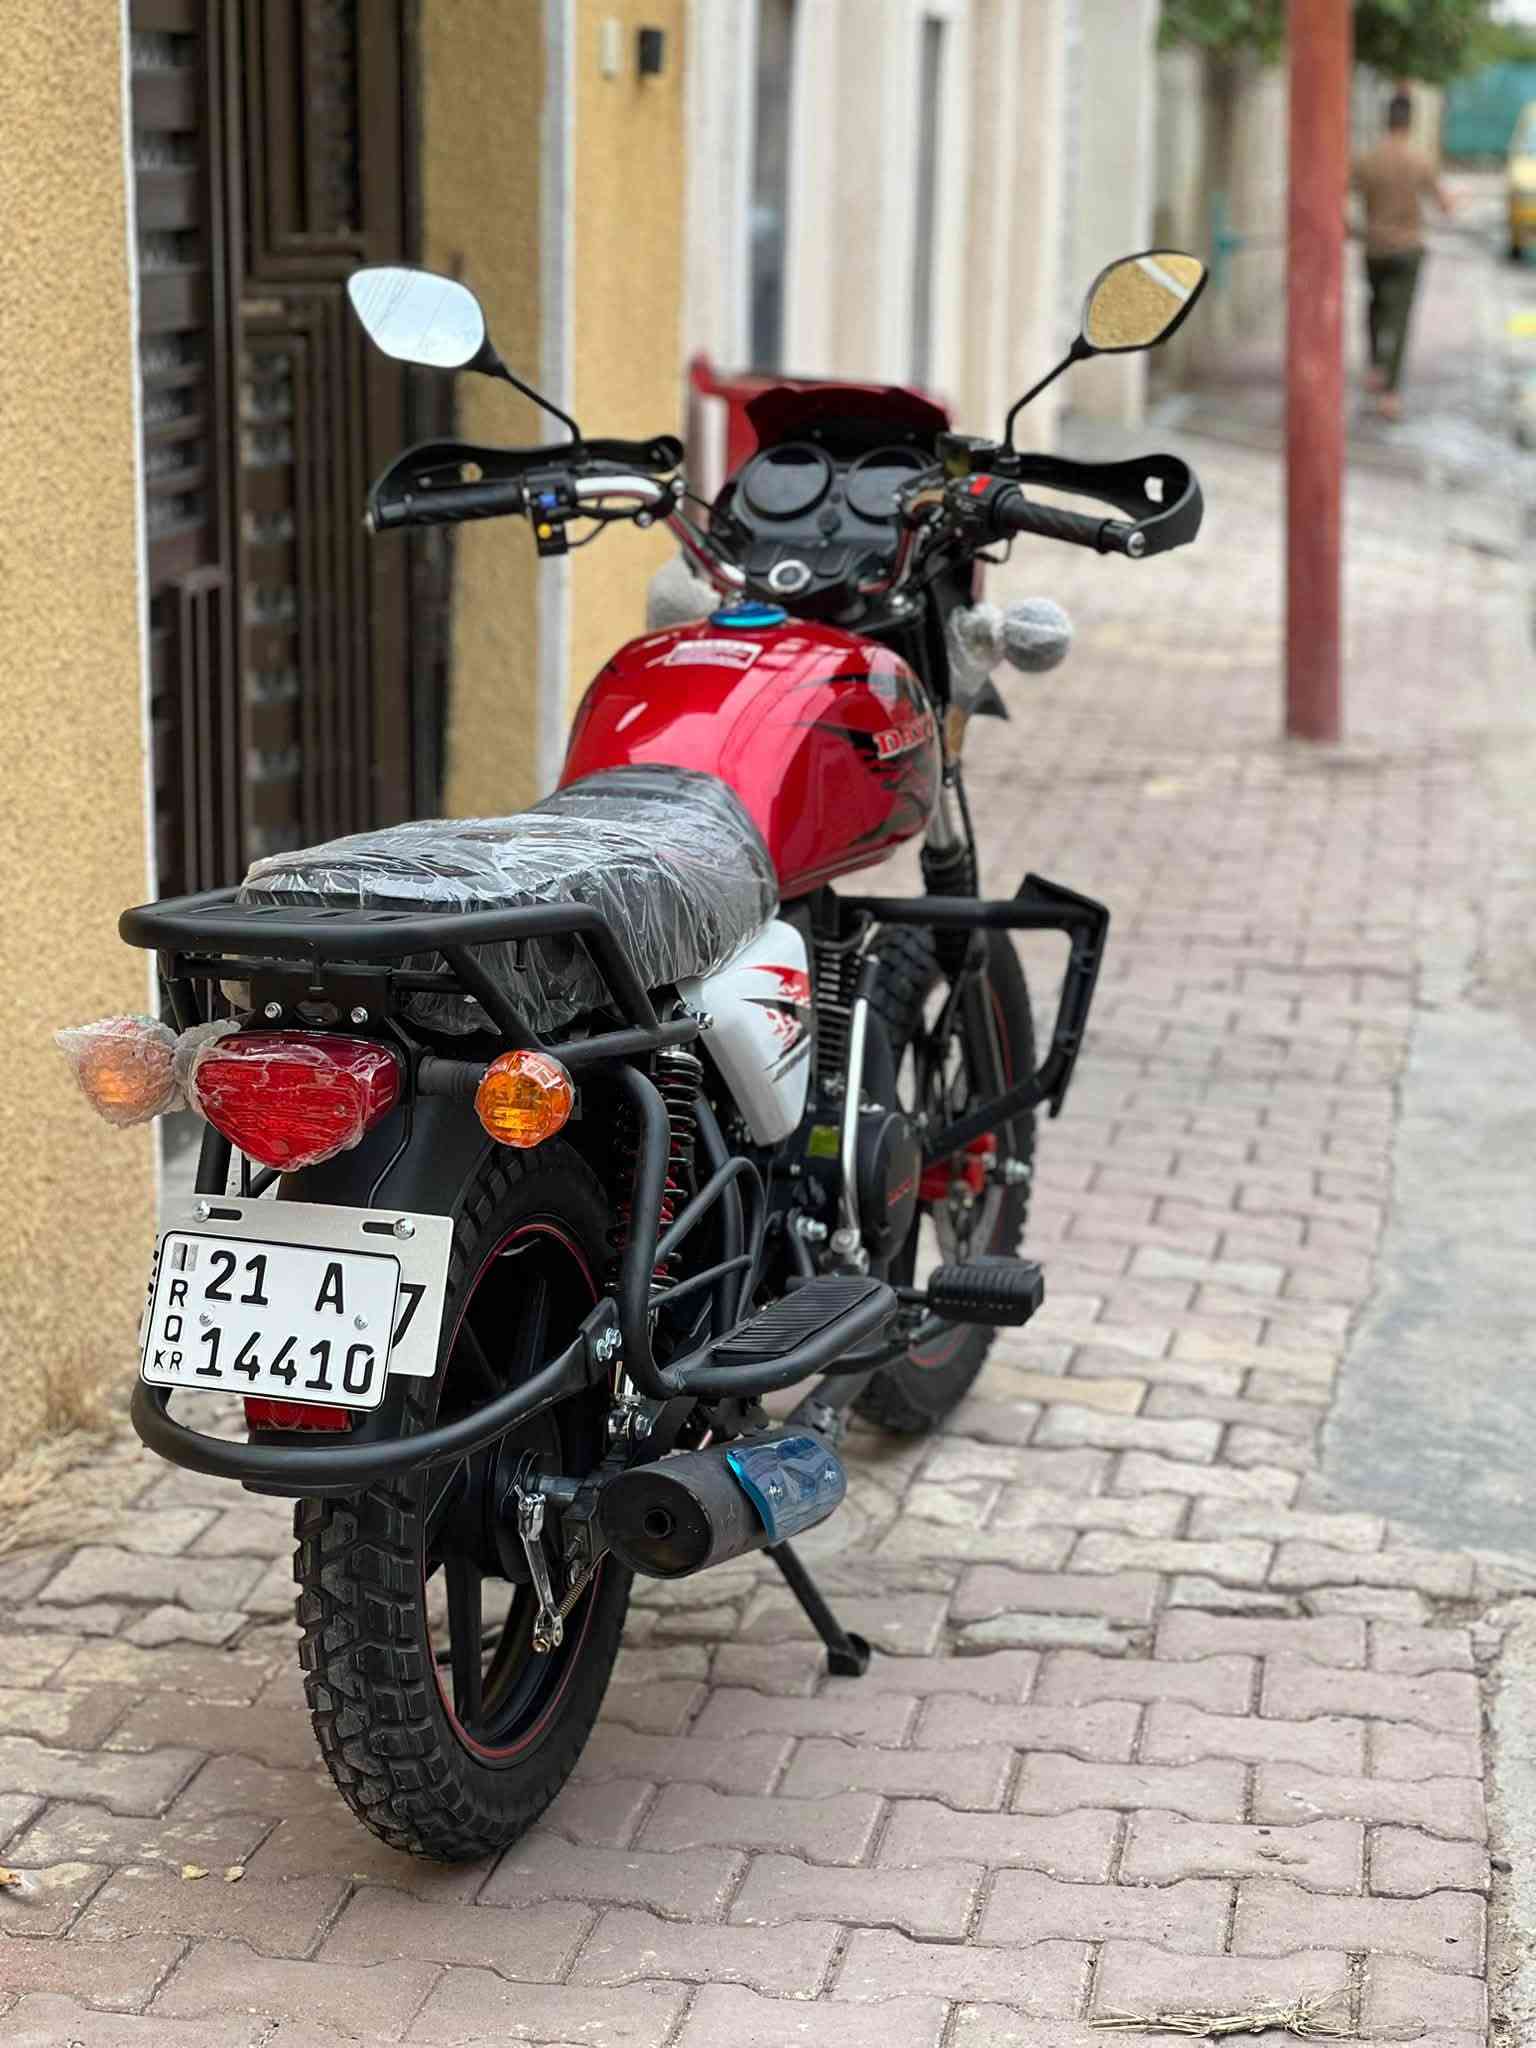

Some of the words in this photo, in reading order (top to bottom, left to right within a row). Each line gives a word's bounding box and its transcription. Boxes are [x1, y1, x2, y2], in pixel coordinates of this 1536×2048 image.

[204, 1250, 269, 1306] 21
[314, 1262, 345, 1314] A
[153, 1349, 183, 1371] KR
[195, 1327, 376, 1395] 14410
